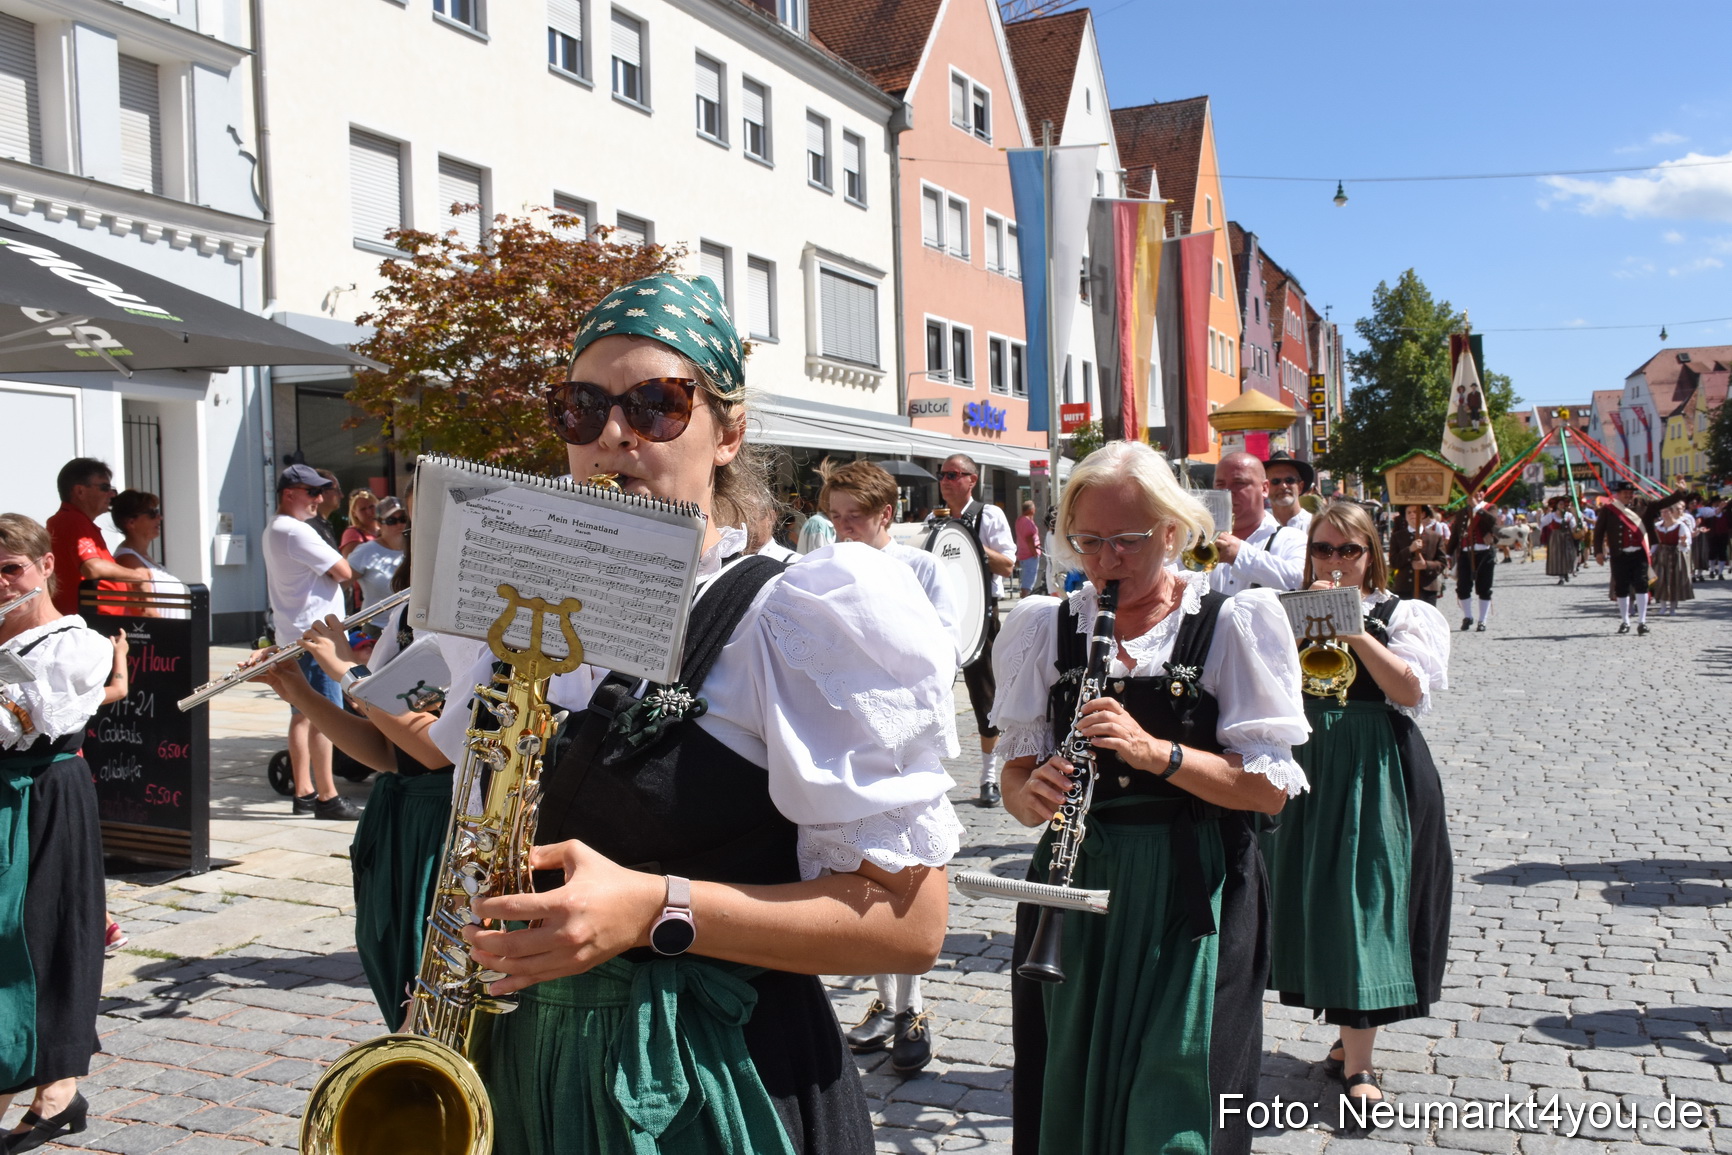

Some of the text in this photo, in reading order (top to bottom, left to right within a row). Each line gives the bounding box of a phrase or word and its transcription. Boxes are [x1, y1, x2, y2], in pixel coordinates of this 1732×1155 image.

[1063, 412, 1085, 422] WITT
[1311, 375, 1326, 453] HOTEL
[547, 513, 619, 536] Mein Heimatland
[142, 645, 181, 673] Hour
[98, 716, 143, 745] Cocktails
